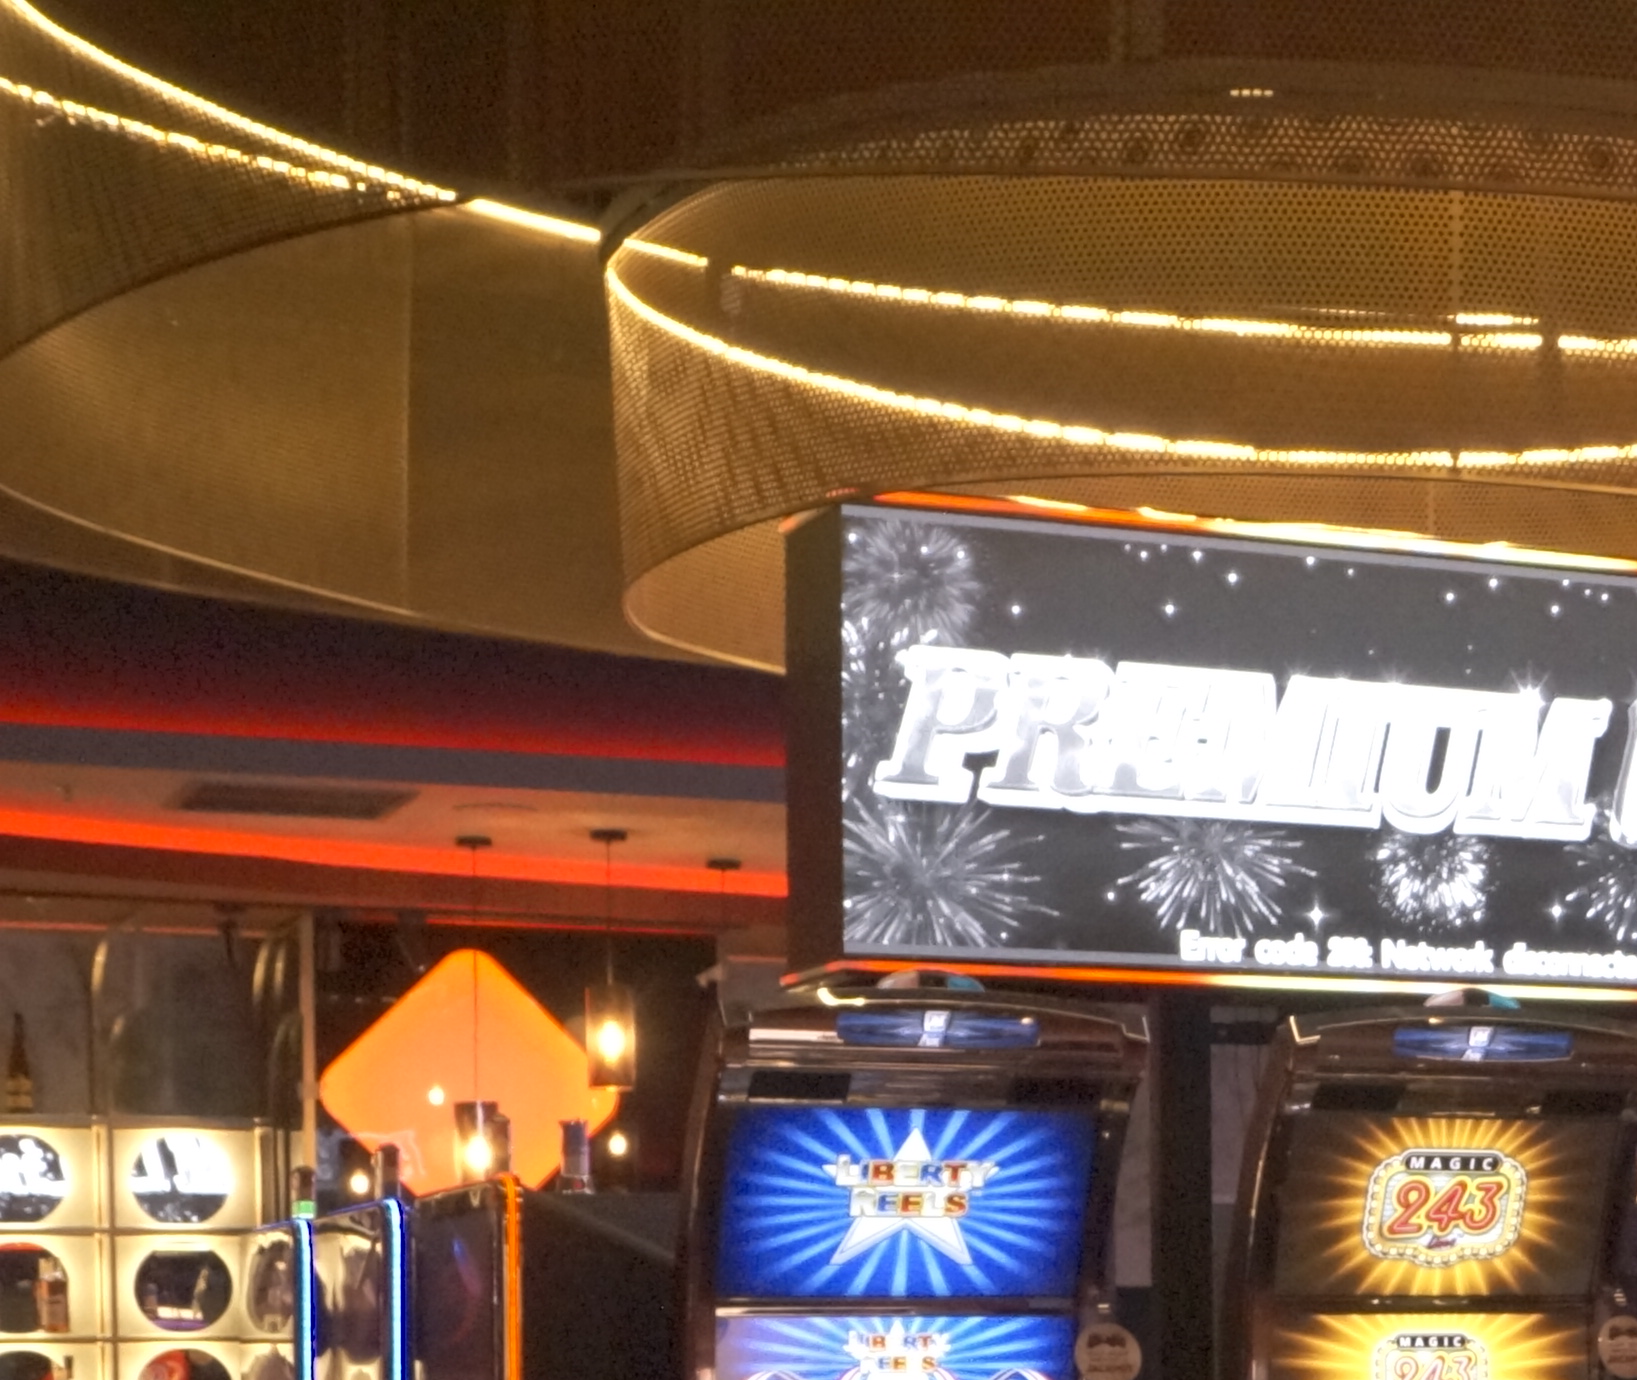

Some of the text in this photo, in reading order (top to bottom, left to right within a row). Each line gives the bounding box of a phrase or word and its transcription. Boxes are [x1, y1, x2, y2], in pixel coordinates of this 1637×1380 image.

[874, 645, 1612, 842] PREMIUM
[1180, 929, 1246, 963] Error
[1254, 932, 1319, 967] code
[1380, 938, 1494, 974] Network
[836, 1154, 994, 1188] LIBERTY
[1409, 1157, 1494, 1170] MAGIC
[850, 1187, 969, 1217] REELS
[1386, 1179, 1504, 1236] 243
[848, 1330, 951, 1353] LIBRTY
[1399, 1336, 1462, 1348] MAGIC
[860, 1356, 937, 1373] REES
